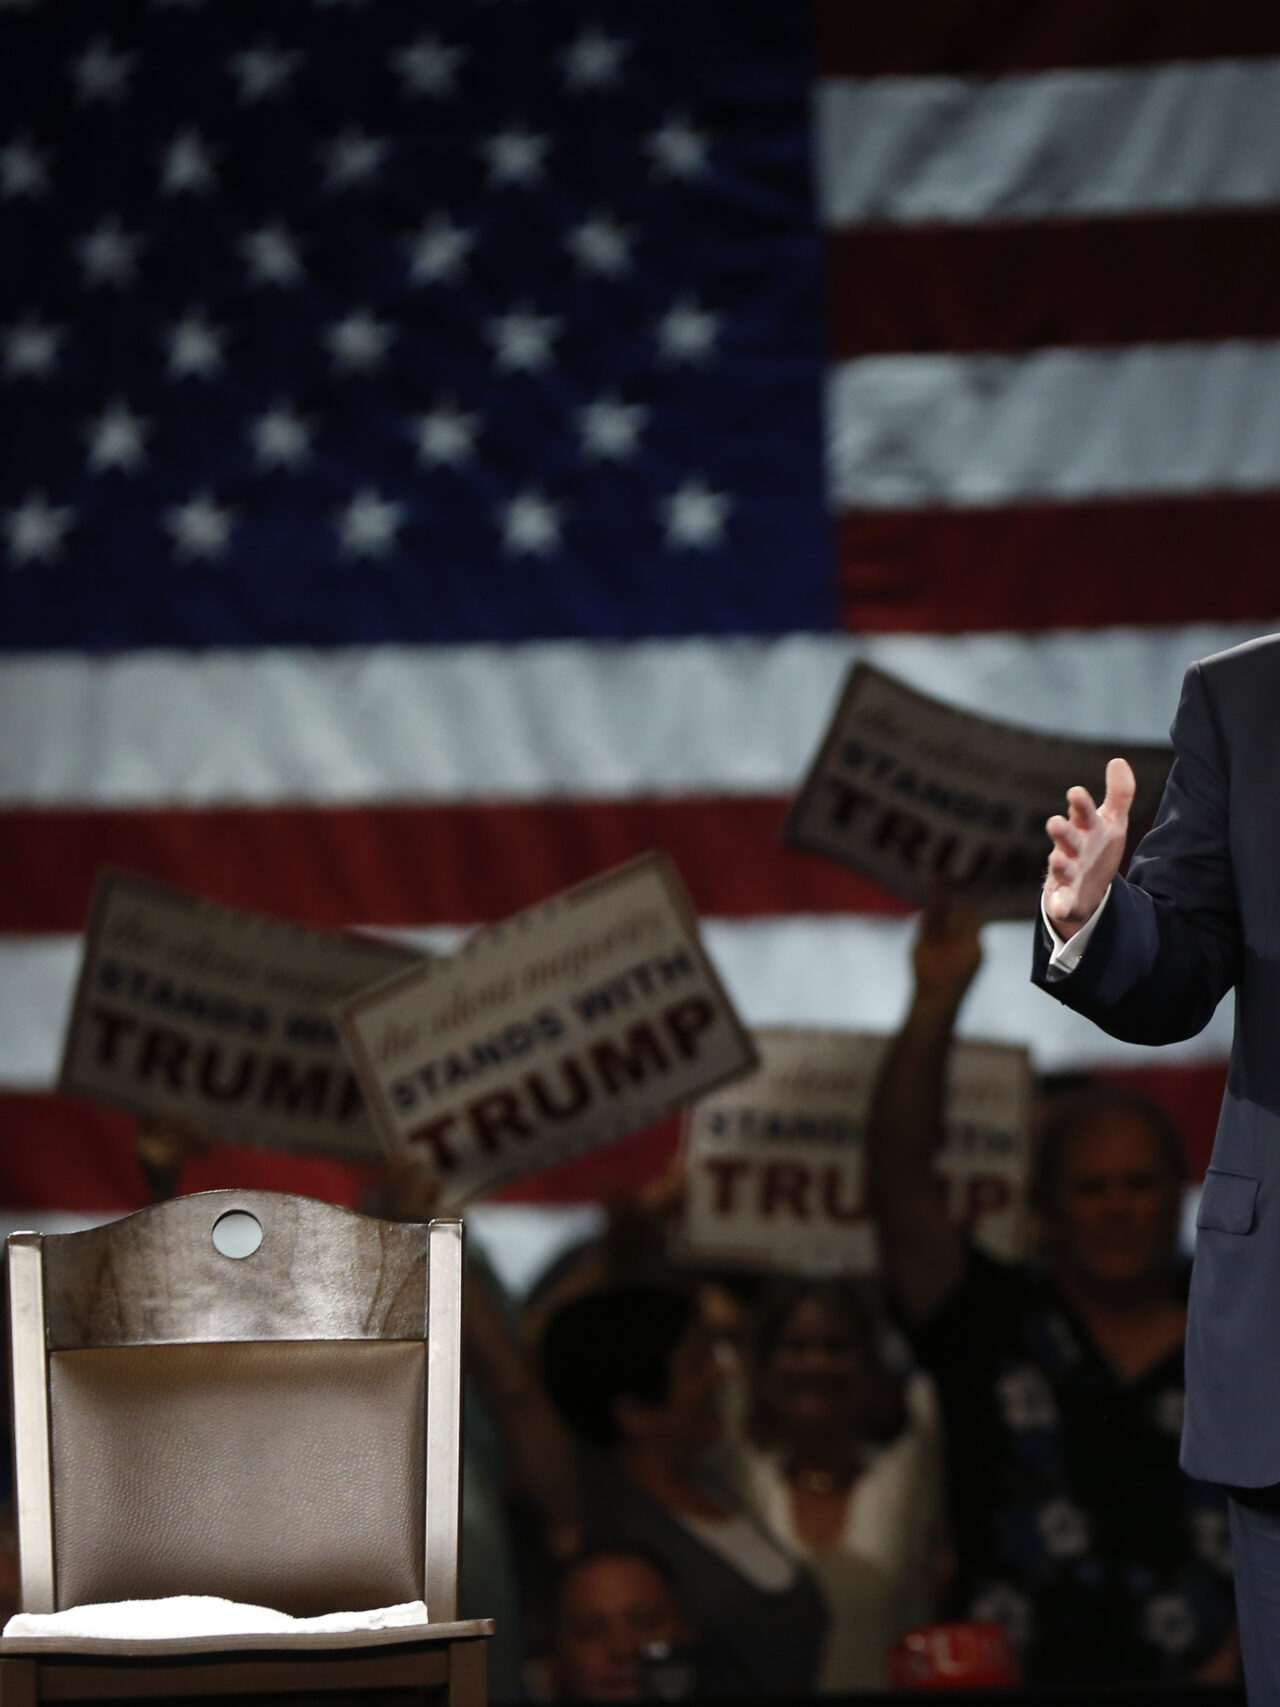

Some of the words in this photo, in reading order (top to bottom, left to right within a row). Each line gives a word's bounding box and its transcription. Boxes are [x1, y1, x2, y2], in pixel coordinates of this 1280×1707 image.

[842, 737, 1013, 830] STANDS
[99, 956, 271, 1037] STANDS
[391, 1006, 565, 1113] STANDS
[573, 945, 696, 1023] WITH
[407, 995, 715, 1174] TRUMP
